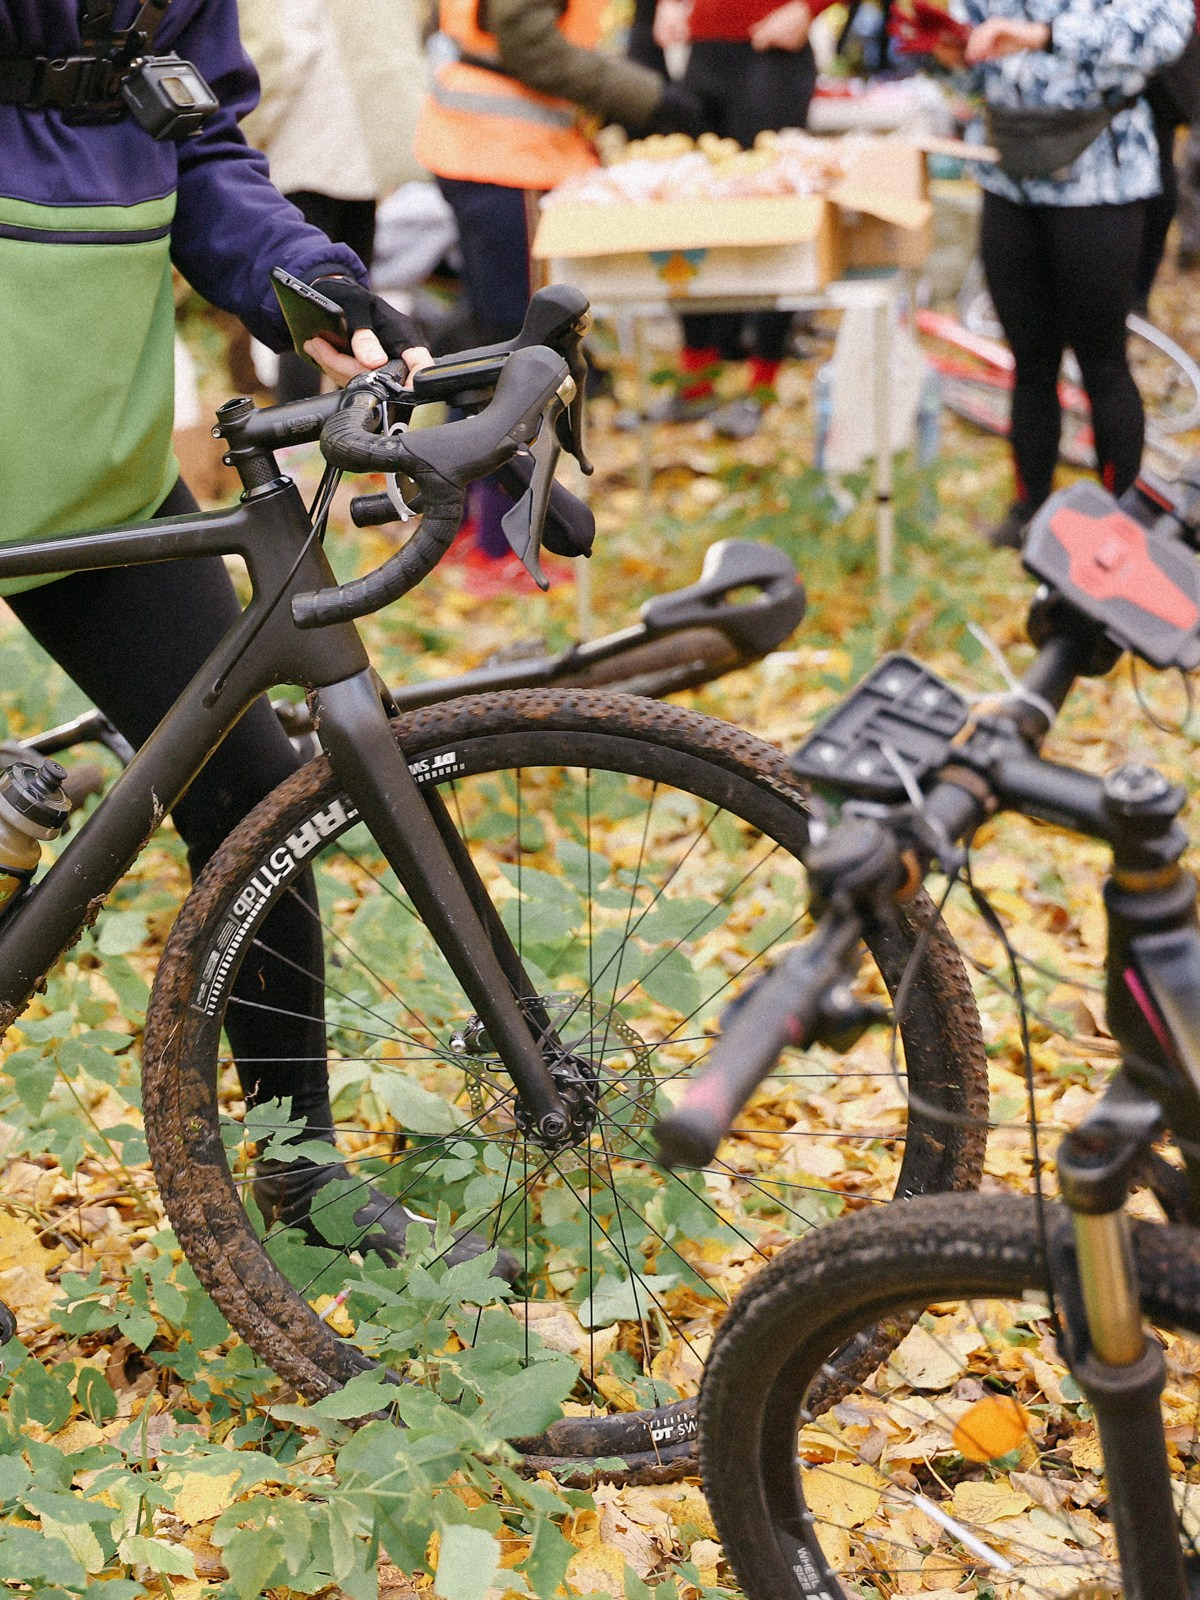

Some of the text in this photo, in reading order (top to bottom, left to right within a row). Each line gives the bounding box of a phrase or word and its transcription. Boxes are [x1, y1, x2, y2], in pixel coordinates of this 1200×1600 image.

[651, 1426, 674, 1441] DT
[792, 1564, 811, 1590] SIZE
[797, 1546, 820, 1589] WHEEL
